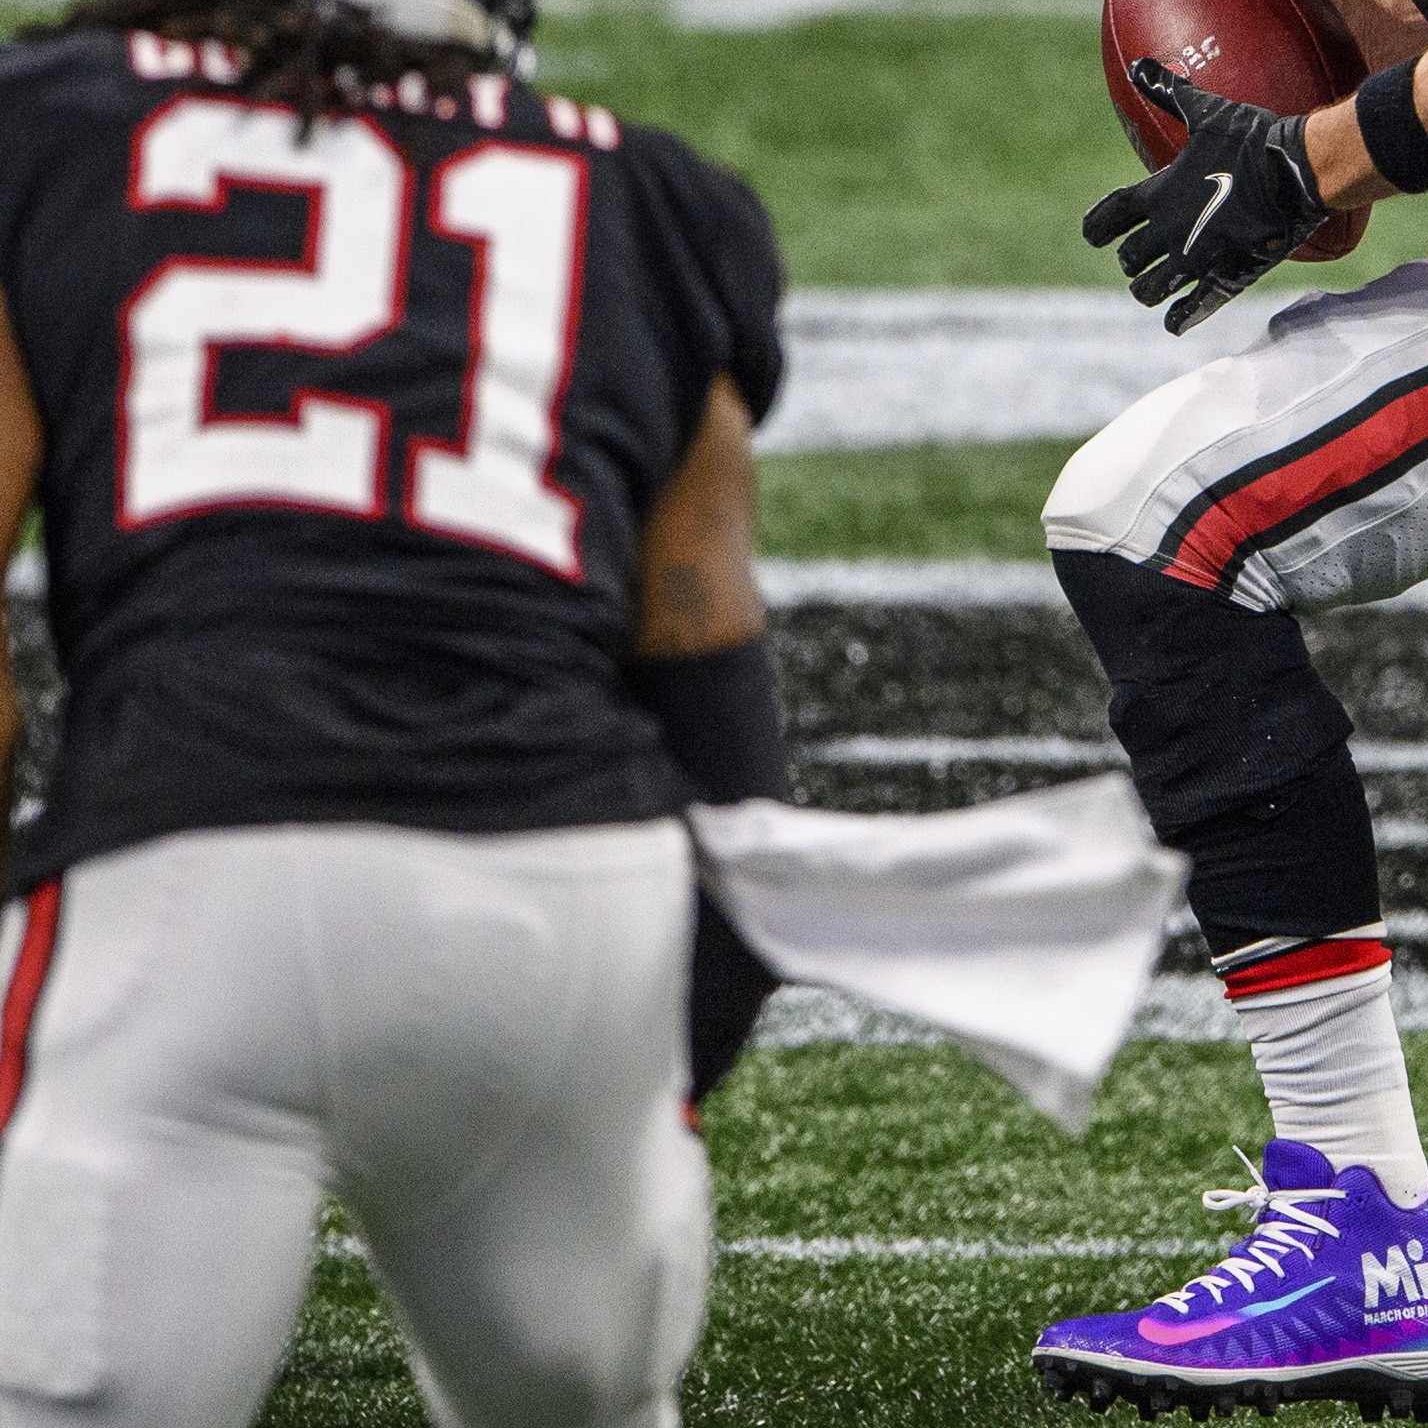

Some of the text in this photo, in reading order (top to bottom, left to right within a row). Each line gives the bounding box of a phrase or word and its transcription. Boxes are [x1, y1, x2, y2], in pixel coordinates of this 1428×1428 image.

[115, 95, 590, 584] 21
[1364, 1308, 1402, 1325] MARCH
[1402, 1306, 1417, 1319] OF
